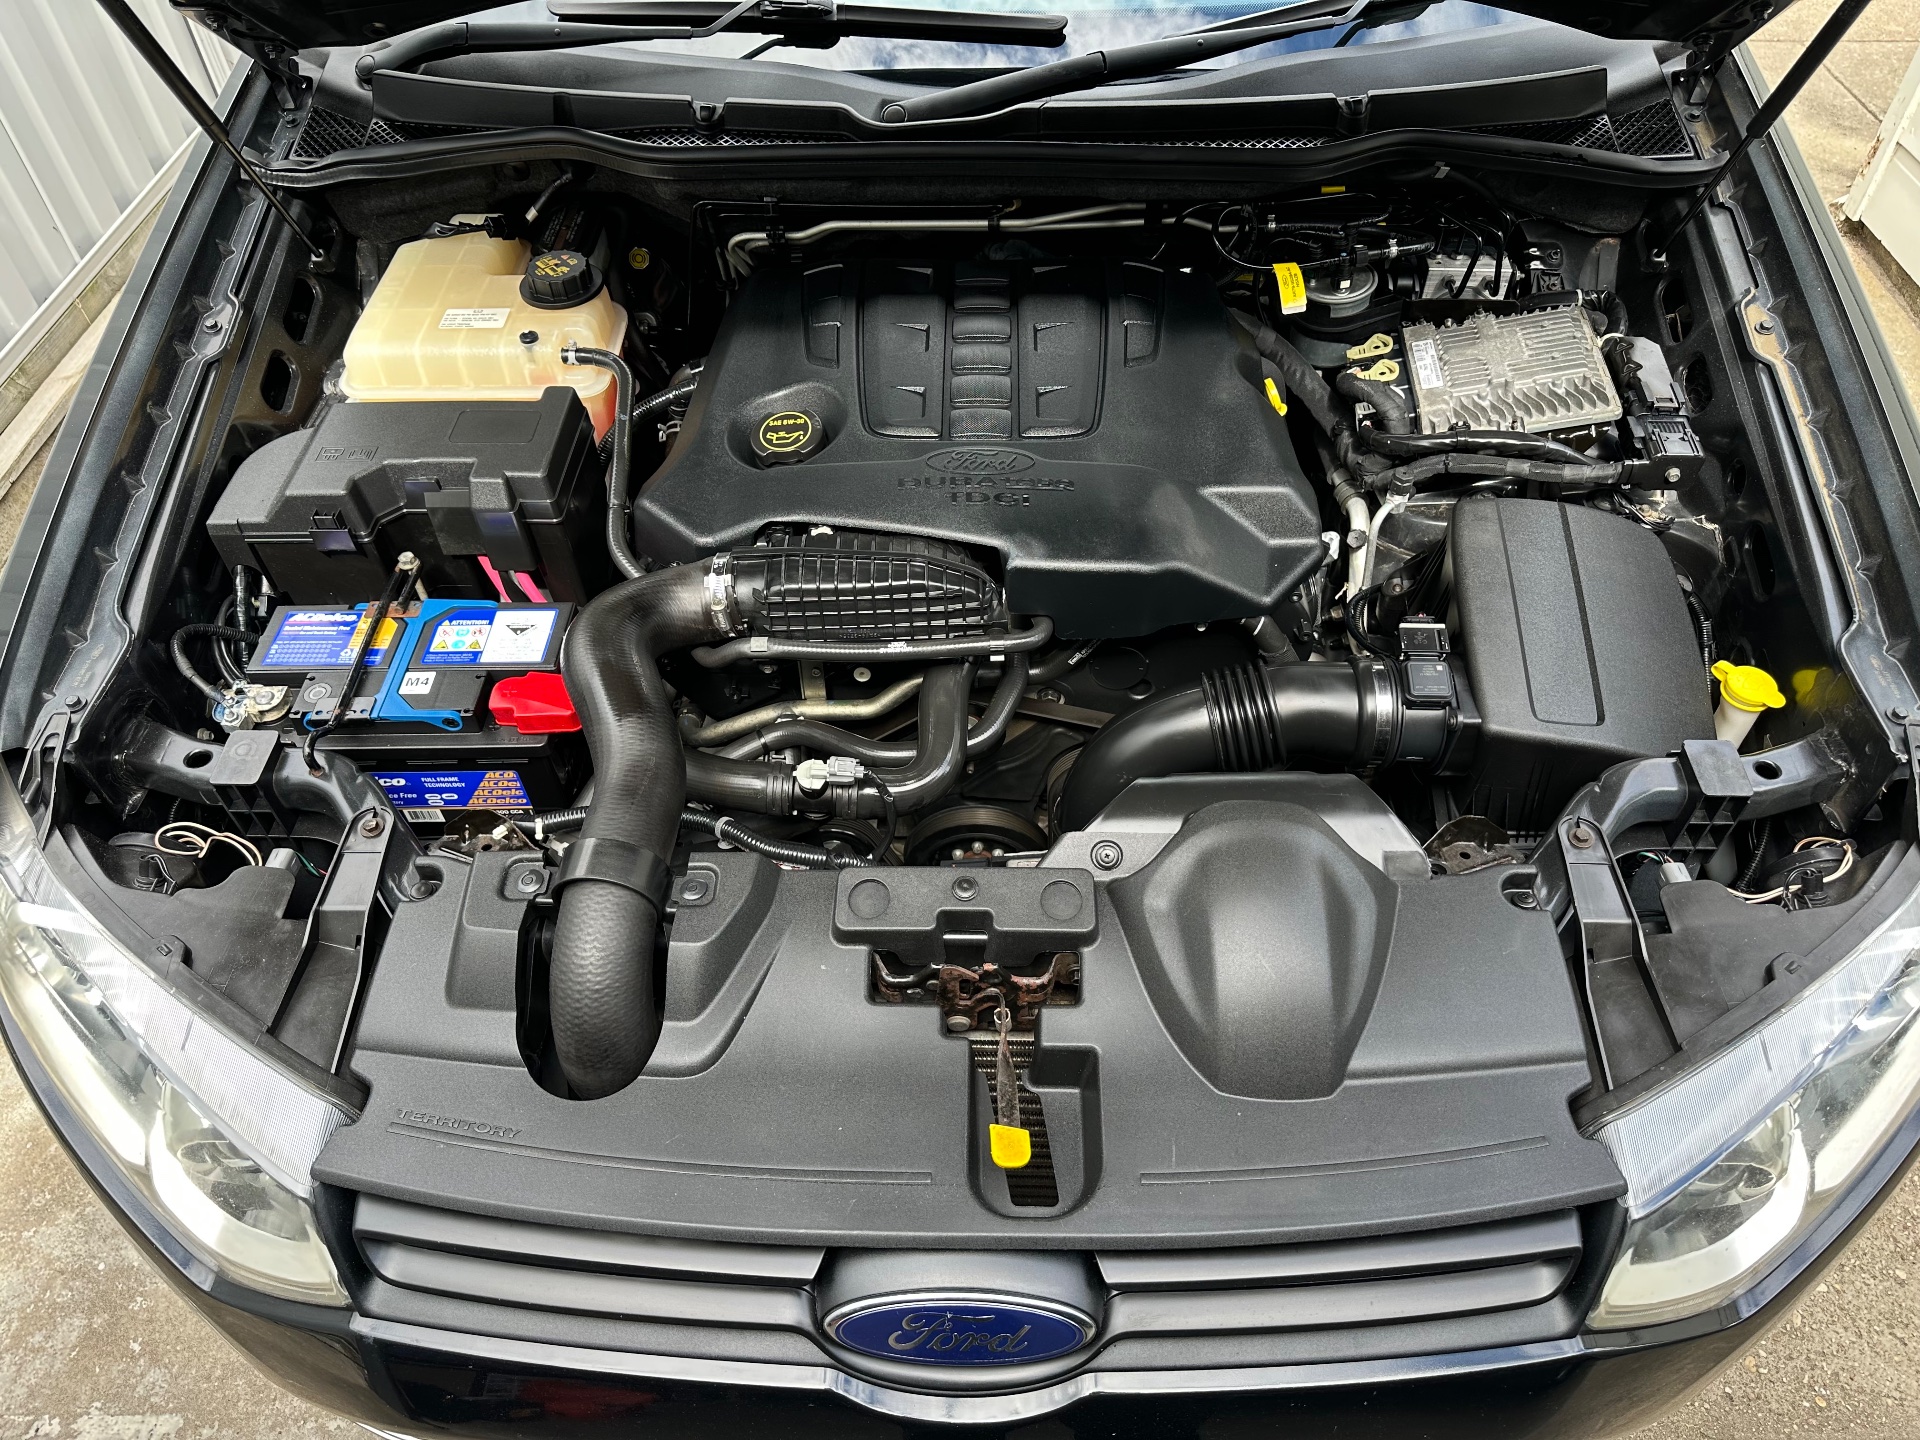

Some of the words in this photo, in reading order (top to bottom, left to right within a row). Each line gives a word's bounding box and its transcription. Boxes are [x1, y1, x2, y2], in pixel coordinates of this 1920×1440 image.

[944, 449, 1018, 471] Ford
[288, 612, 358, 622] ACDelco
[405, 677, 430, 687] M4
[398, 1108, 523, 1139] TERRITORY
[888, 1311, 1032, 1352] Ford
